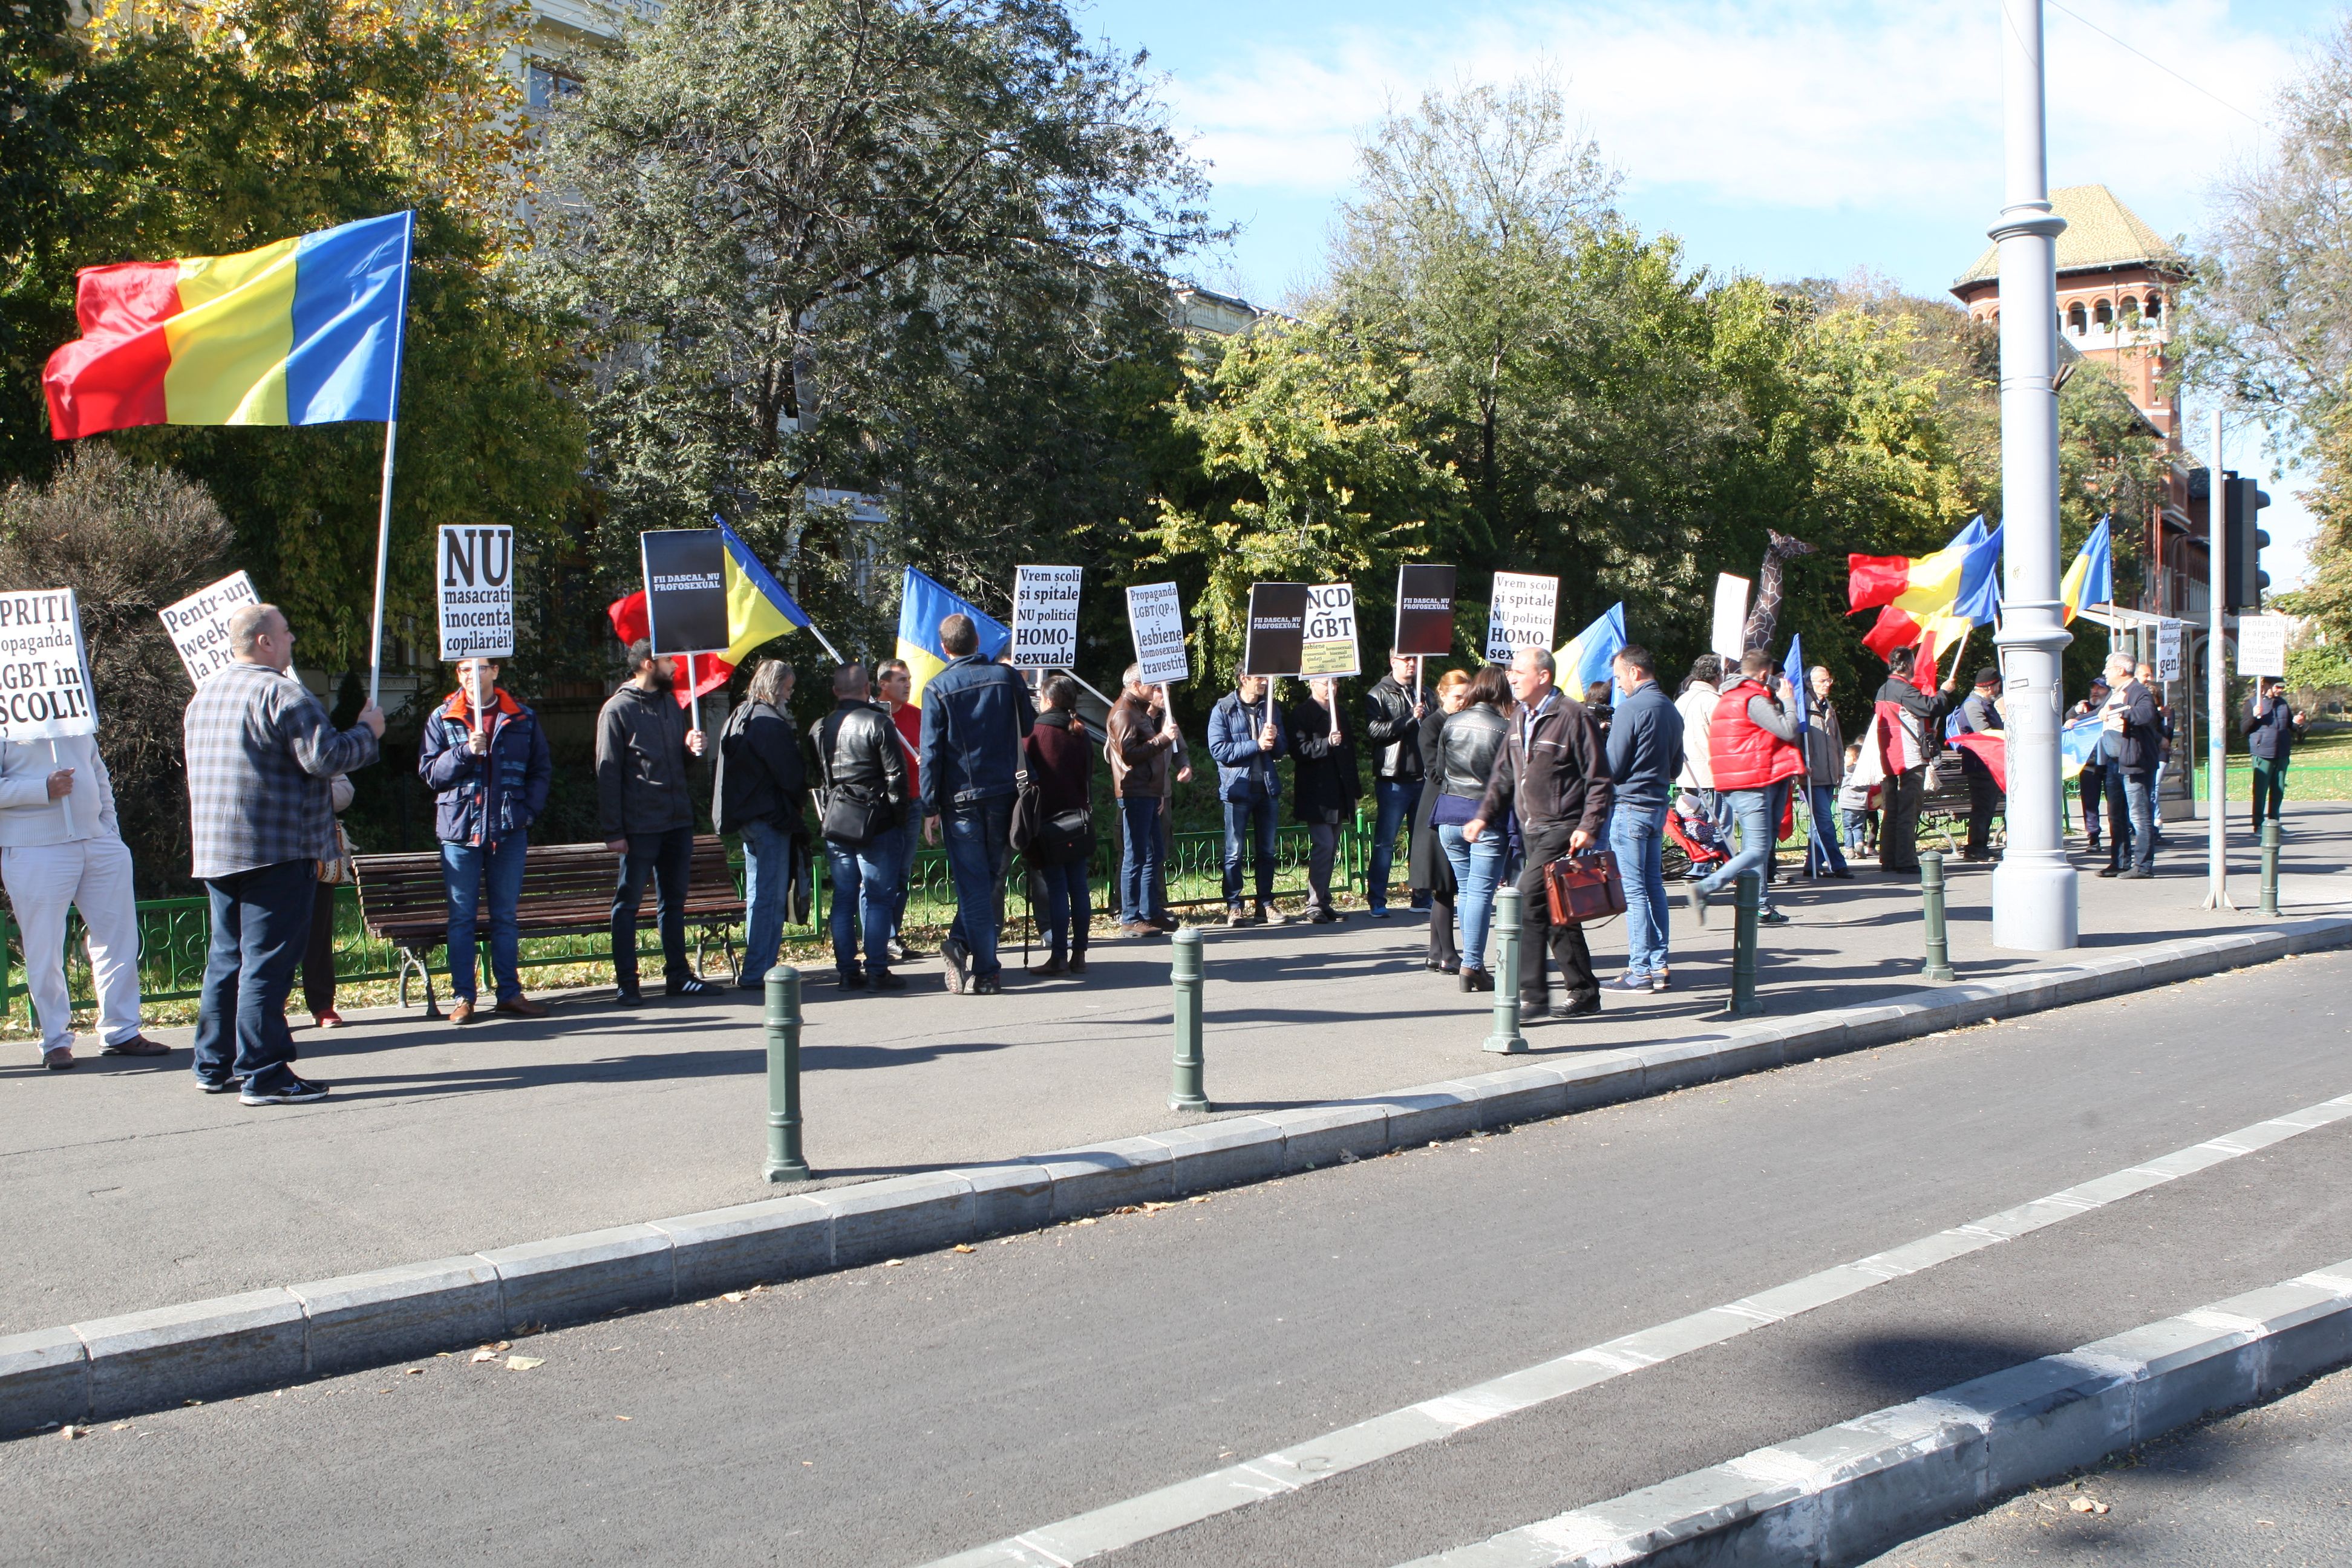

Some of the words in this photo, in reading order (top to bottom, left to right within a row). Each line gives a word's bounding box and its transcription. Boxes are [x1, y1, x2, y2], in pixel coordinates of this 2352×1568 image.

[445, 529, 511, 587] NU
[653, 575, 665, 584] FII
[1021, 569, 1051, 581] Vrem
[1054, 569, 1080, 584] școli
[1497, 576, 1526, 589] Vrem
[654, 581, 720, 591] PROFOSEXUAL
[1131, 585, 1177, 603] Propaganda
[445, 584, 511, 609] masacrați
[1019, 586, 1030, 606] și
[1034, 586, 1078, 604] spitale
[1307, 588, 1351, 609] NCD
[1495, 592, 1504, 608] și
[1509, 592, 1554, 608] spitale
[0, 595, 70, 633] PRIȚI
[163, 580, 250, 633] Pentr-un
[1134, 602, 1178, 618] LGBT(QP+)
[445, 607, 511, 632] inocența
[1018, 609, 1035, 620] NU
[1037, 609, 1076, 624] politici
[1492, 610, 1509, 621] NU
[1512, 613, 1552, 626] politici
[2274, 618, 2284, 627] 30
[1, 629, 73, 656] opaganda
[446, 630, 512, 656] copilăriei!
[1016, 628, 1074, 645] HOMO-
[1137, 627, 1182, 647] lesbiene
[1491, 627, 1550, 645] HOMO-
[1014, 647, 1073, 664] sexuale
[1140, 642, 1184, 658] homosexuali
[1489, 648, 1516, 660] sex
[189, 660, 211, 680] la
[1143, 654, 1186, 674] travestiți
[2160, 653, 2180, 678] gen!
[0, 662, 47, 690] GBT
[53, 659, 80, 685] în
